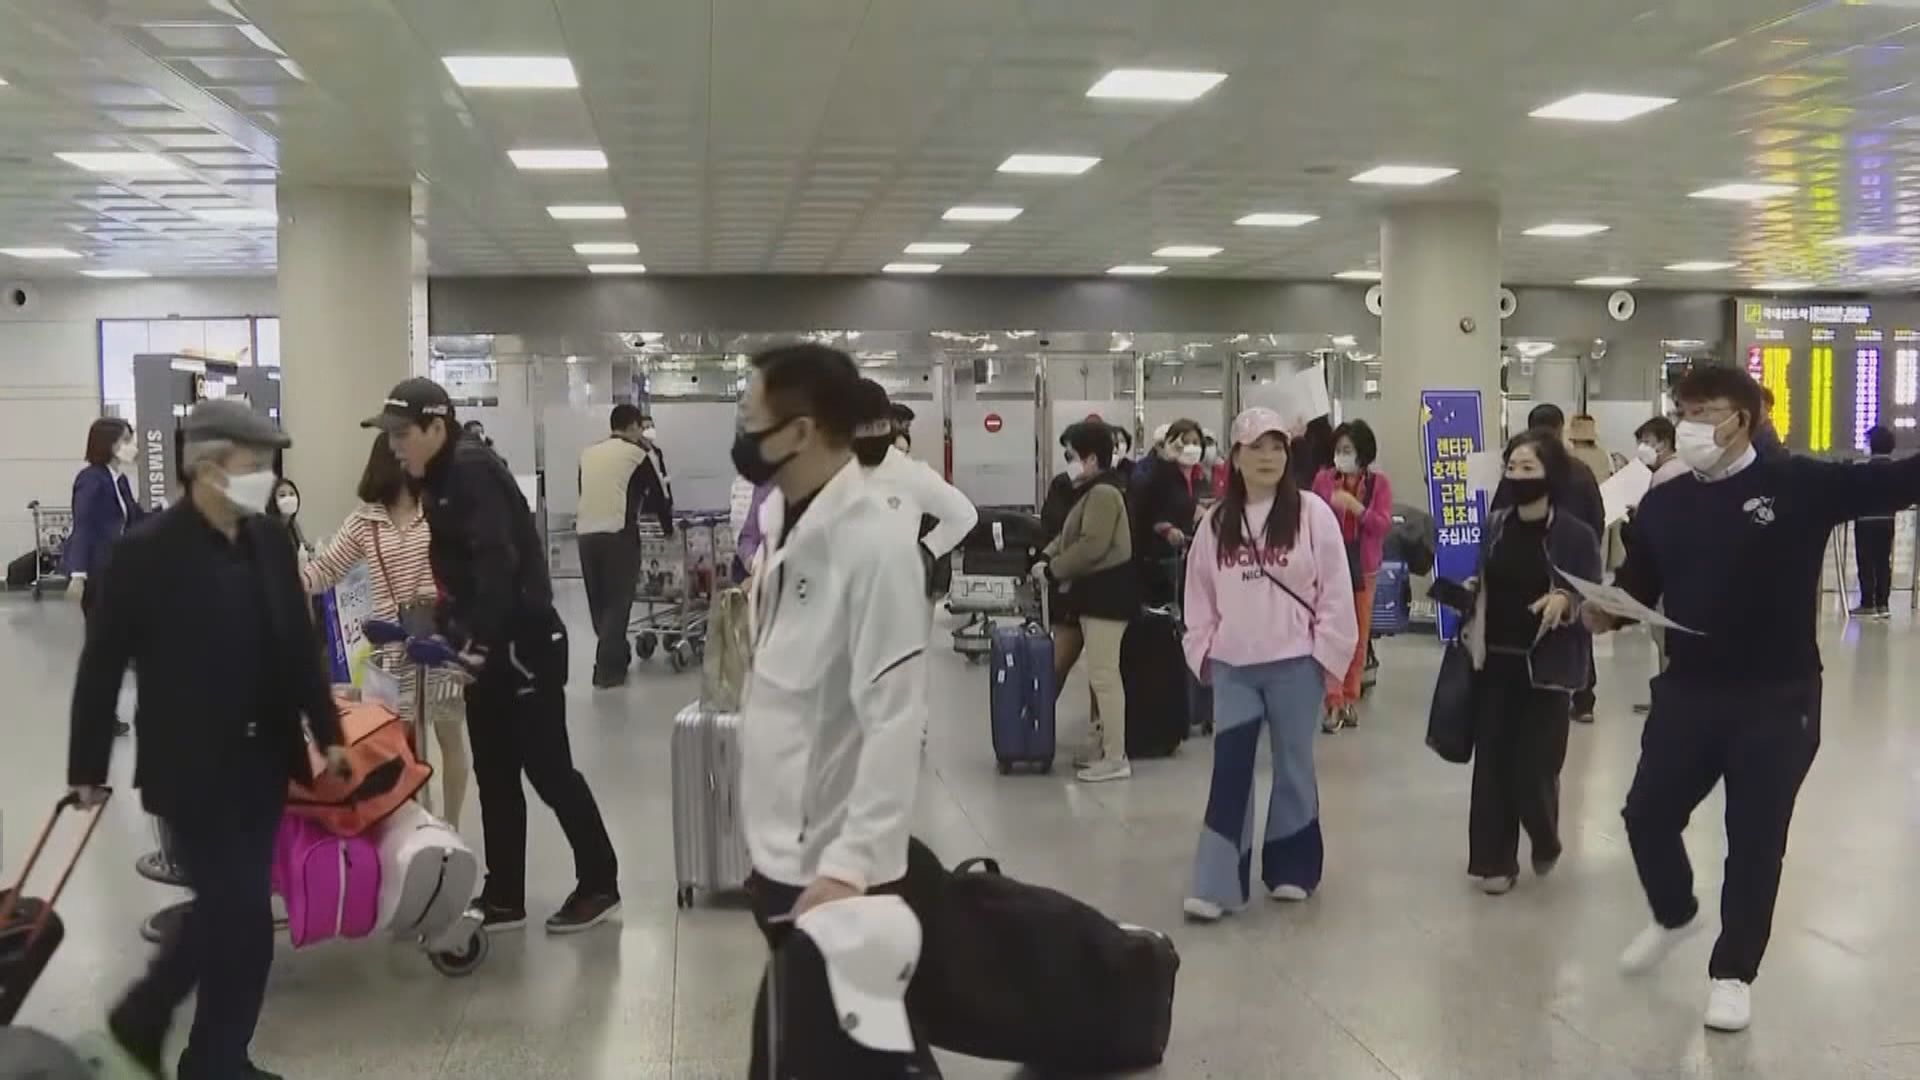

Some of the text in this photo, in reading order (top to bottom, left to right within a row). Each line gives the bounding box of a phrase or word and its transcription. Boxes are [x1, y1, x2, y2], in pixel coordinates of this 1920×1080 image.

[147, 430, 168, 509] SAMSUN
[1432, 460, 1468, 480] 호객행
[1438, 528, 1481, 546] 주십시오
